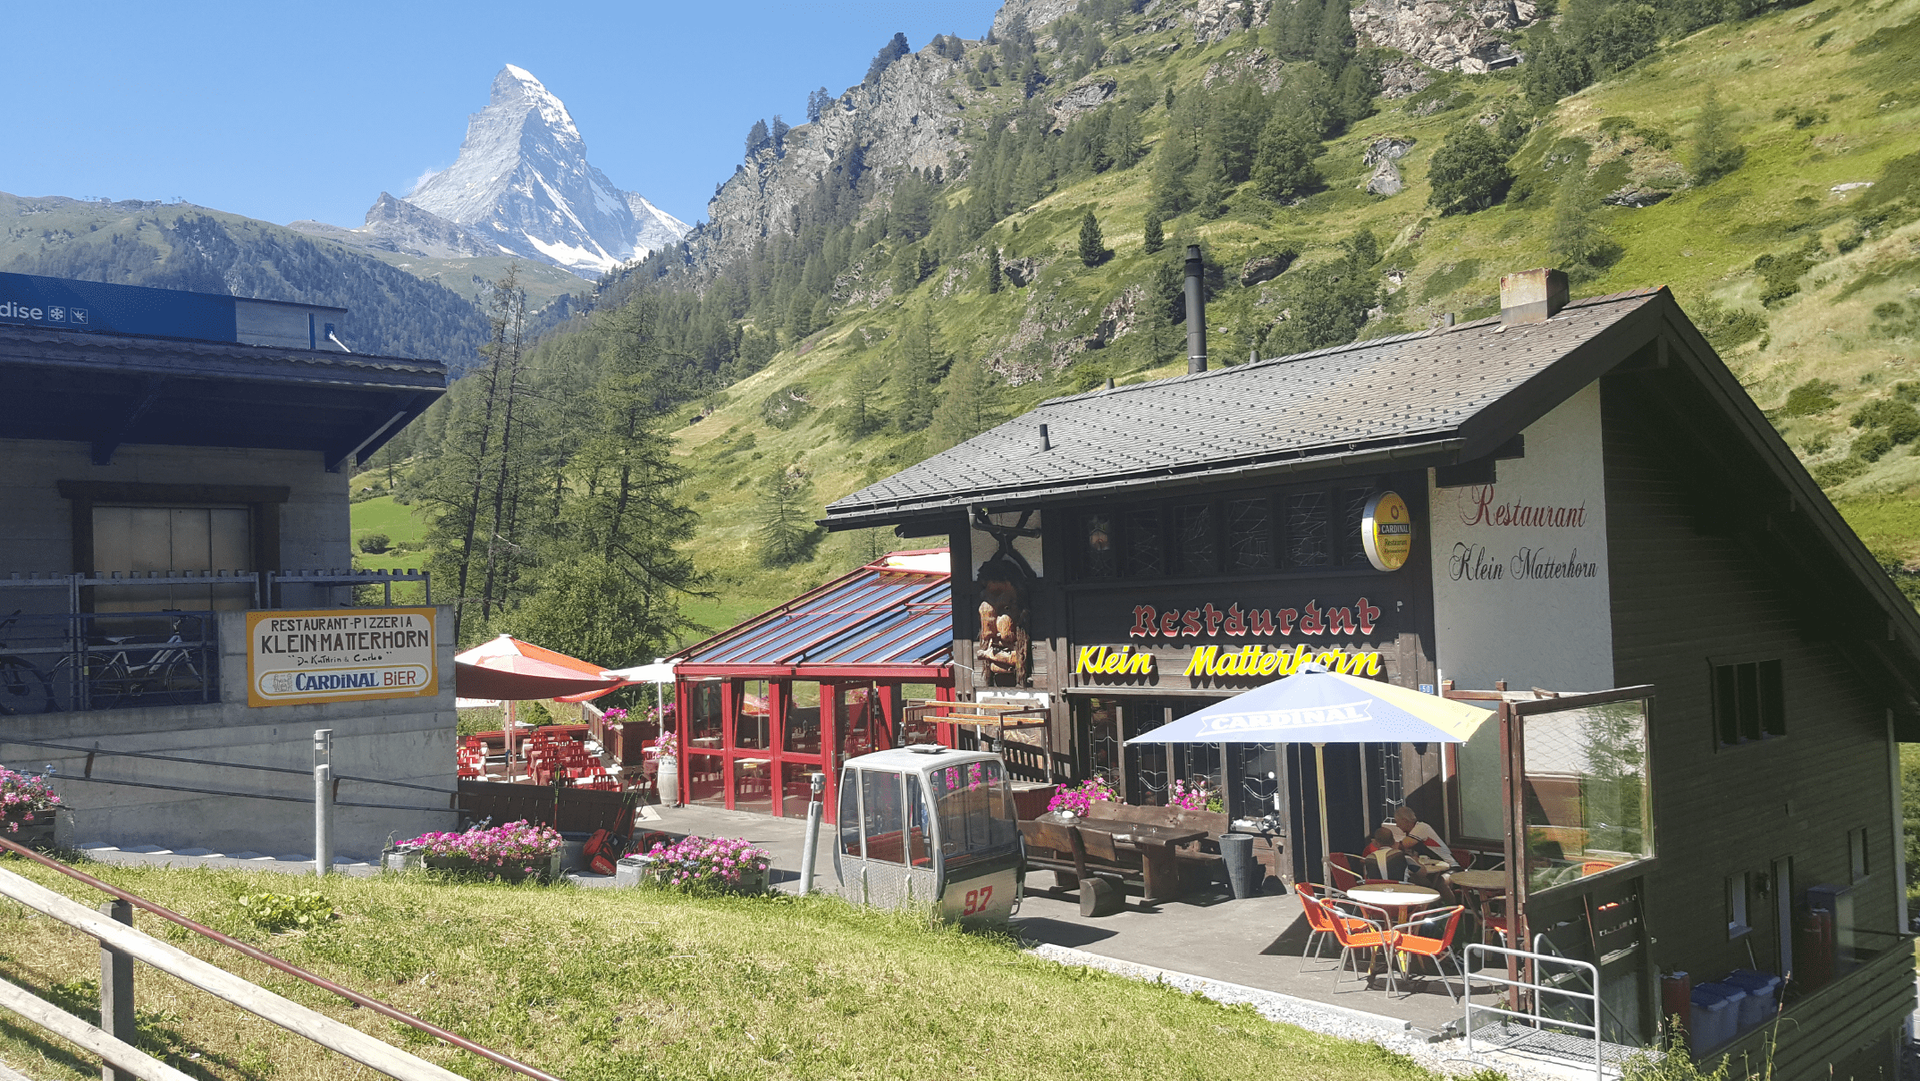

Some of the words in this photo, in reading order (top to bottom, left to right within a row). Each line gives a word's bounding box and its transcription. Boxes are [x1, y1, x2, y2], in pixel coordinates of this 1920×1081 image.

[1458, 483, 1588, 528] Restaurant
[1381, 524, 1409, 534] CARDINAL
[1449, 541, 1504, 581] Klein
[1510, 546, 1600, 581] Matterhorn
[1129, 597, 1381, 638] Restaurant
[1075, 645, 1156, 675] Klein
[1182, 644, 1382, 677] Matterhorn
[1210, 706, 1364, 731] CARDINAL
[963, 885, 993, 916] 97
